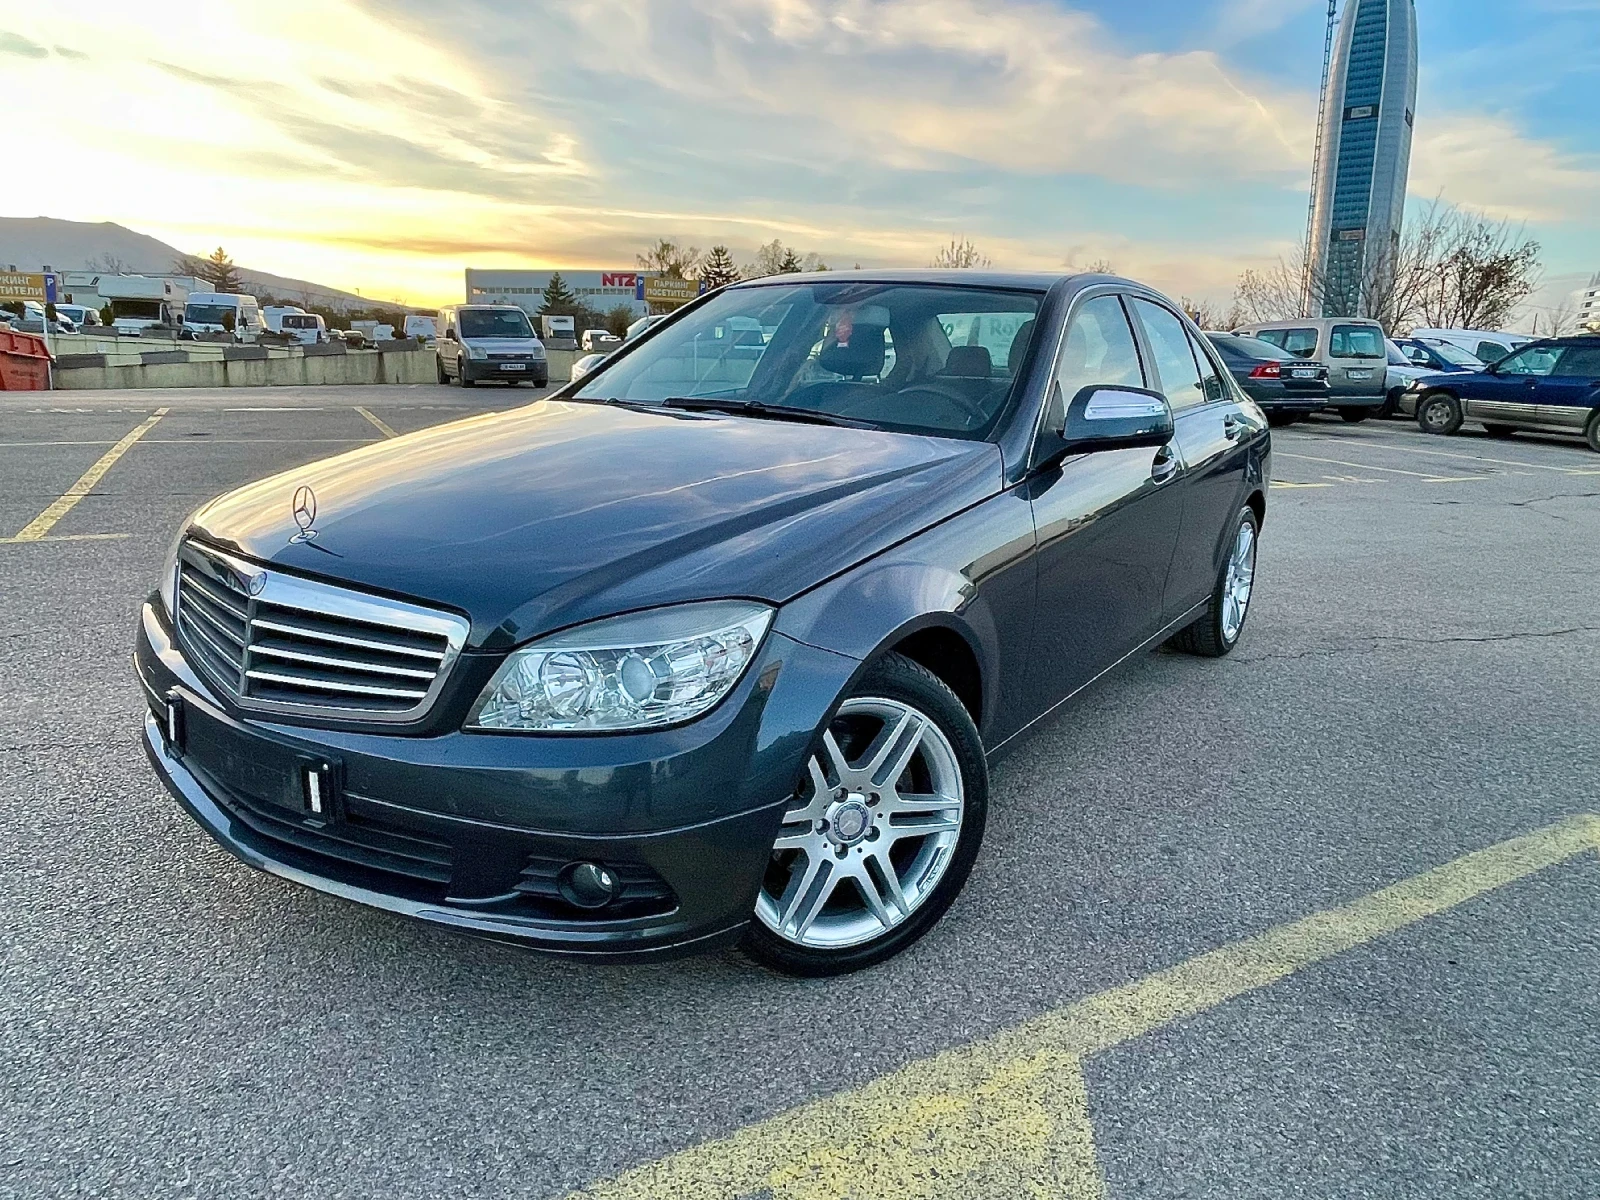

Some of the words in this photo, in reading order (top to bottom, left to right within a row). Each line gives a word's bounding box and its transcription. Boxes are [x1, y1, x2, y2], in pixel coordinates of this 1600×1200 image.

[0, 276, 31, 284] КИНГ
[602, 273, 637, 287] NTZ
[653, 280, 690, 289] ПАРКИНГ
[646, 288, 698, 297] ПОСЕТИТЕЛИ
